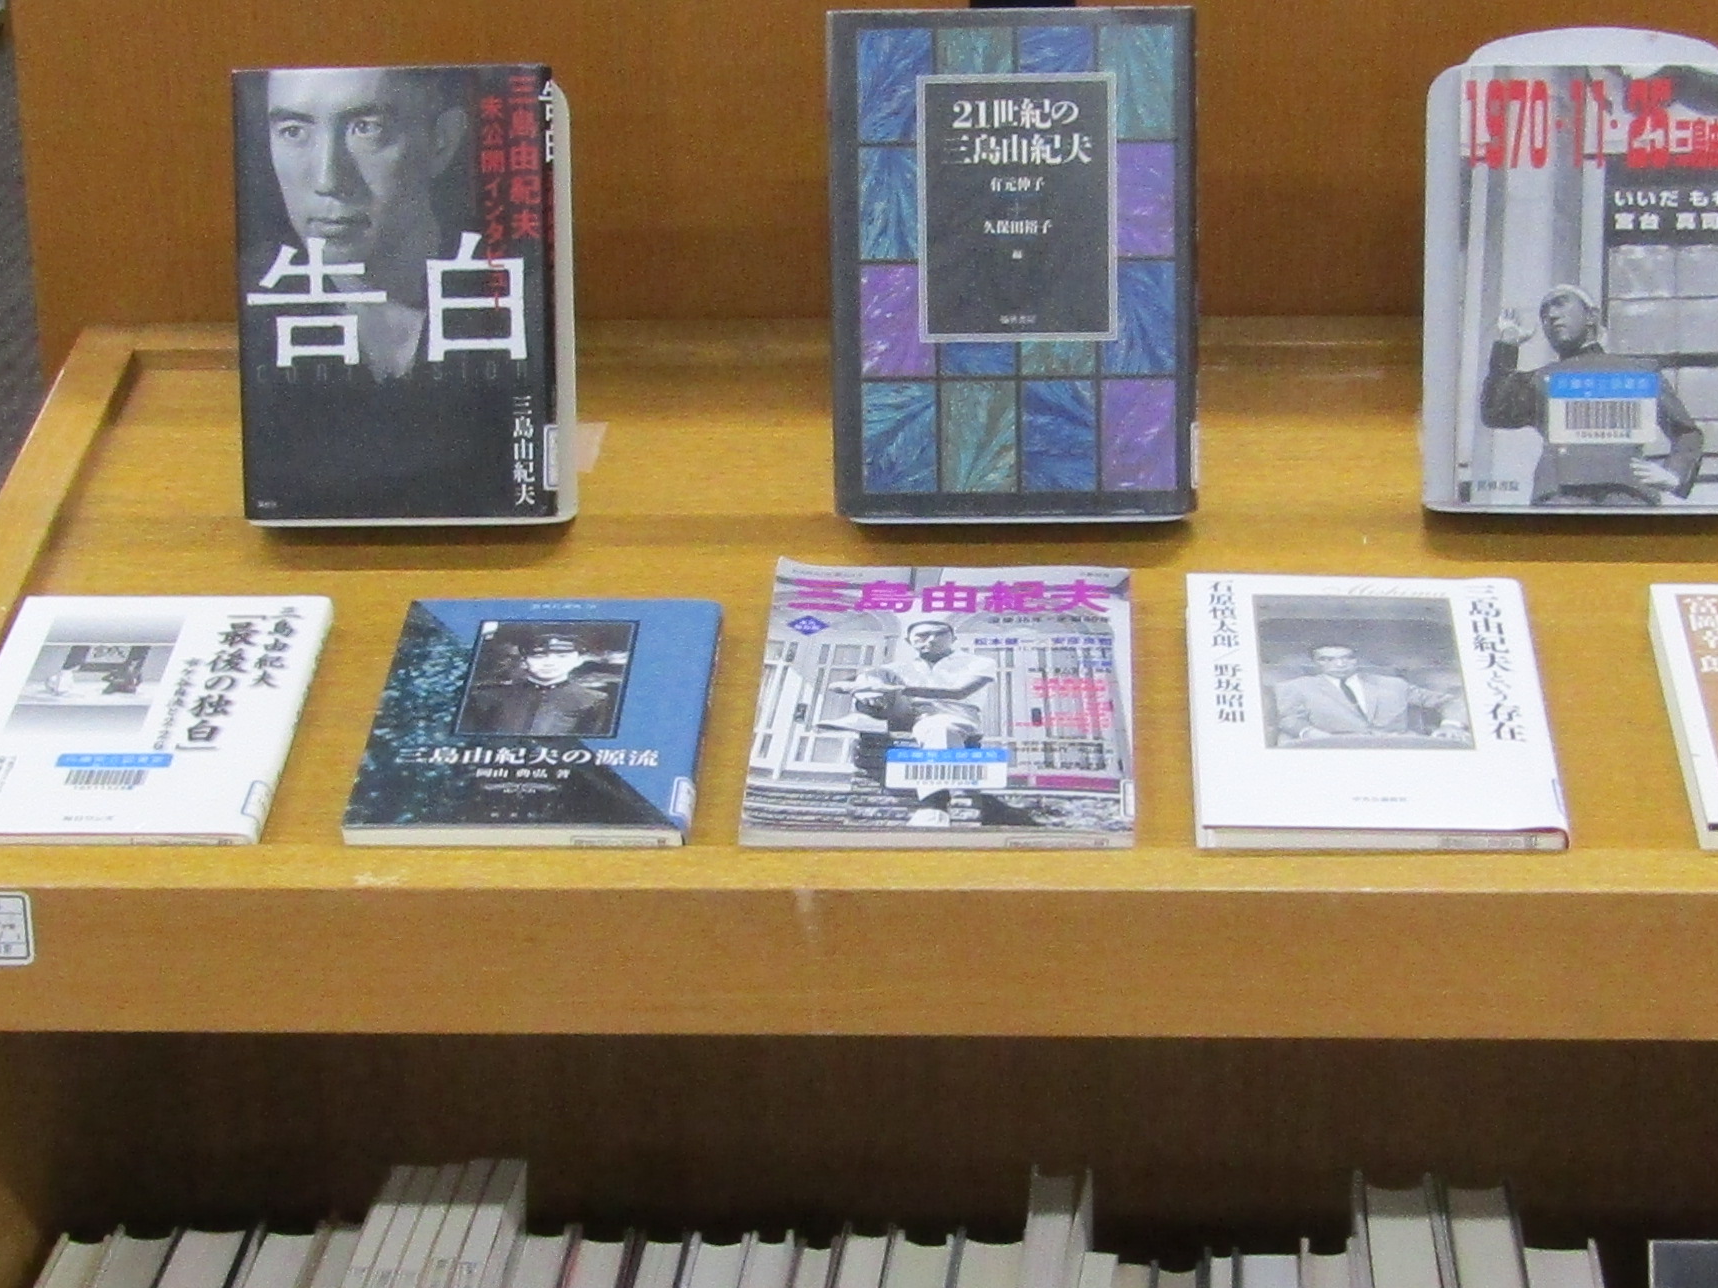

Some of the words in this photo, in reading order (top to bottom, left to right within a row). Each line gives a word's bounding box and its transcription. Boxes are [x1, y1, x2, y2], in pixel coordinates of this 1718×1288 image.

[952, 97, 1079, 129] 21世紀の
[508, 75, 541, 240] 三島由紀夫
[943, 133, 1092, 165] 三島由紀夫
[1615, 189, 1680, 208] いいだ
[246, 232, 528, 367] 告白
[513, 394, 536, 506] 三島由紀夫
[788, 578, 1110, 613] 三島由紀夫
[250, 606, 304, 688] 三島由紀夫
[1467, 583, 1527, 743] 三島由紀夫という存在
[395, 746, 660, 767] 三島由紀夫の源流
